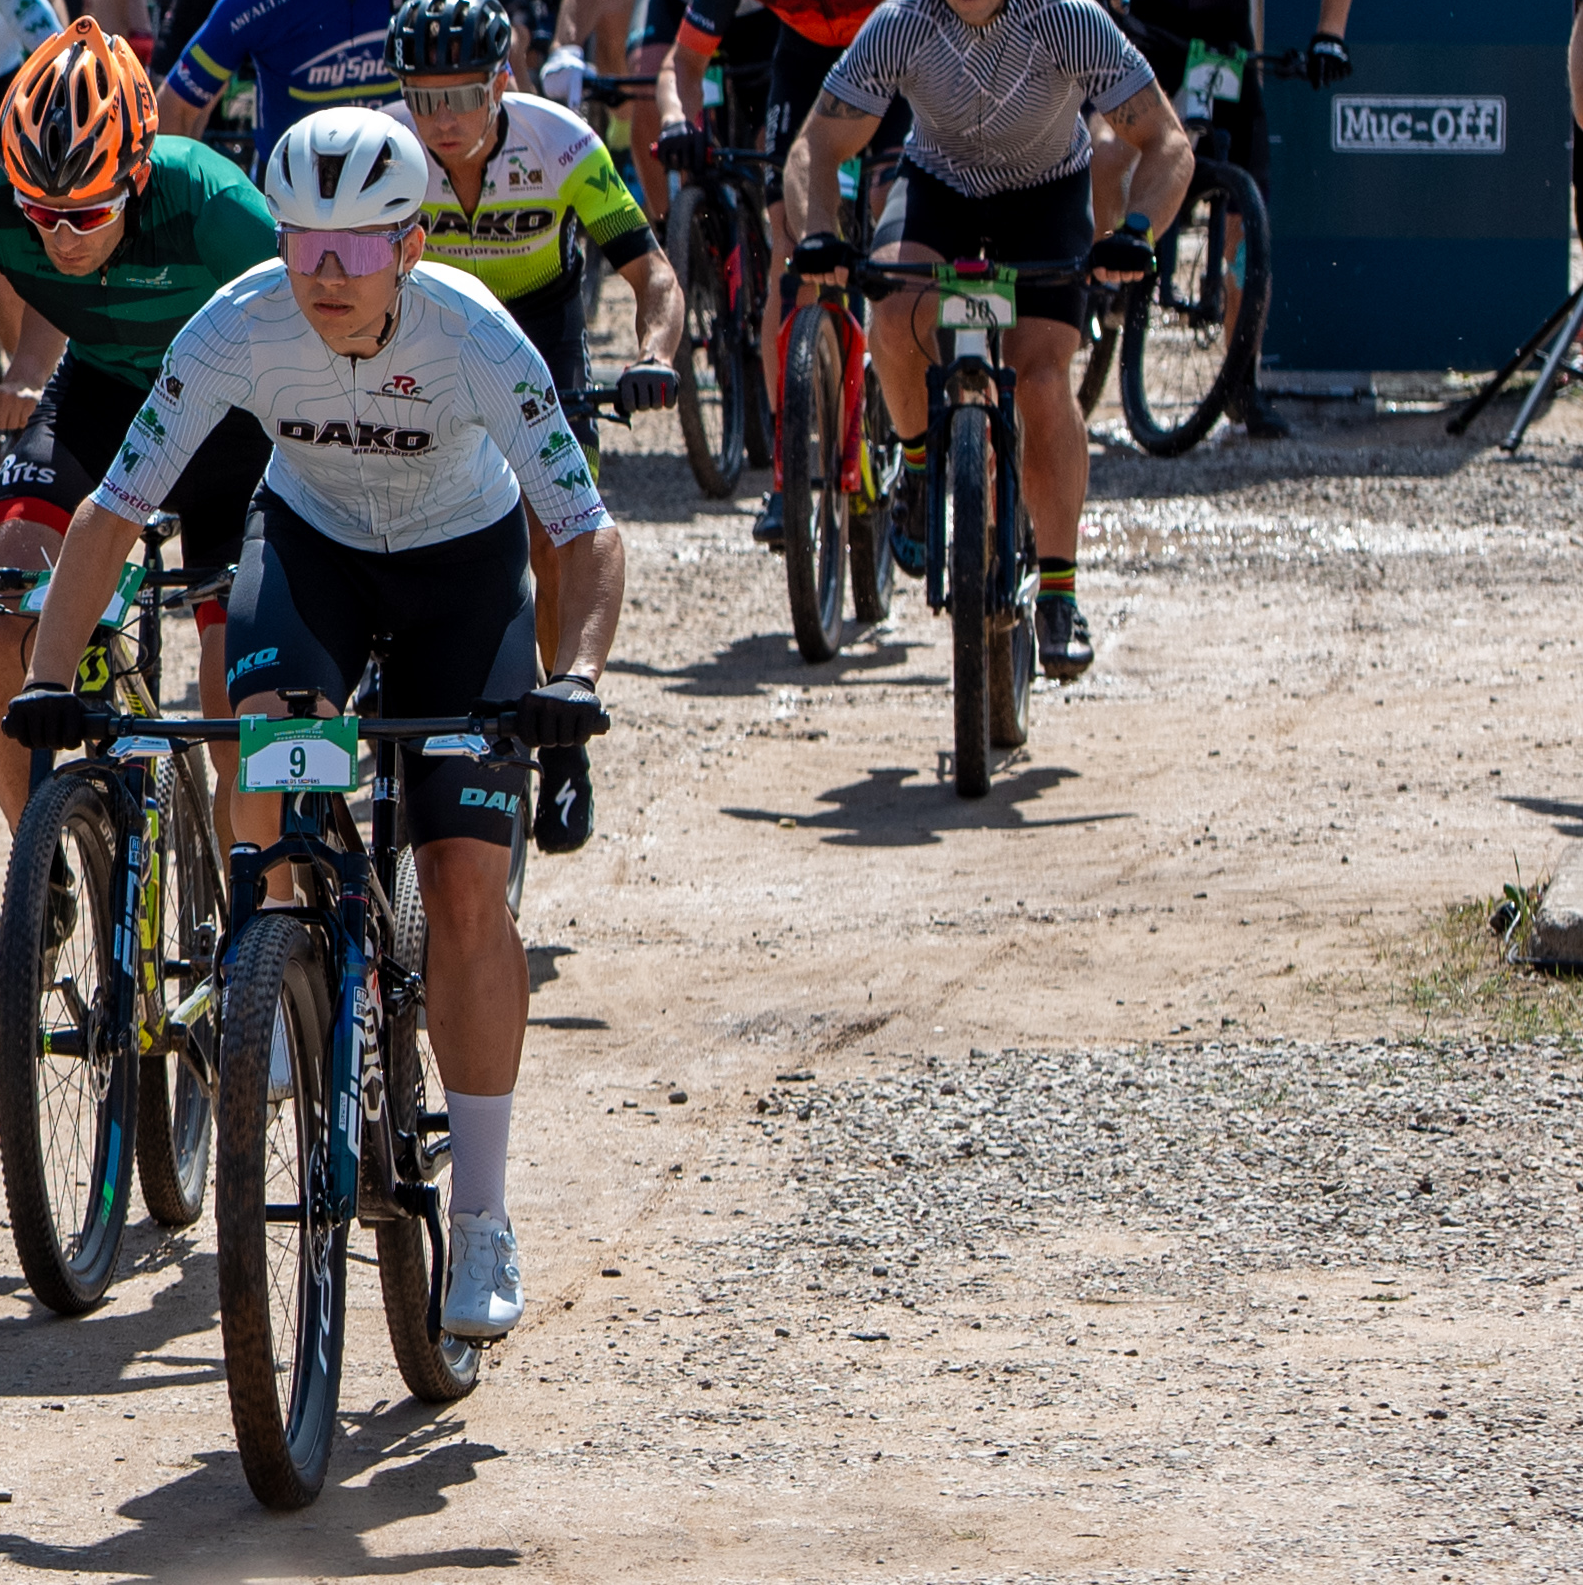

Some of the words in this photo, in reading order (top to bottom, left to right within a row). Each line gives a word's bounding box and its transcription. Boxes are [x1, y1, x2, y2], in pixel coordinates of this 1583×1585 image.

[307, 54, 388, 84] mySpo
[1345, 104, 1492, 143] Muc-Off
[276, 418, 434, 452] DAKO
[289, 746, 307, 778] 9
[459, 787, 519, 816] DAK
